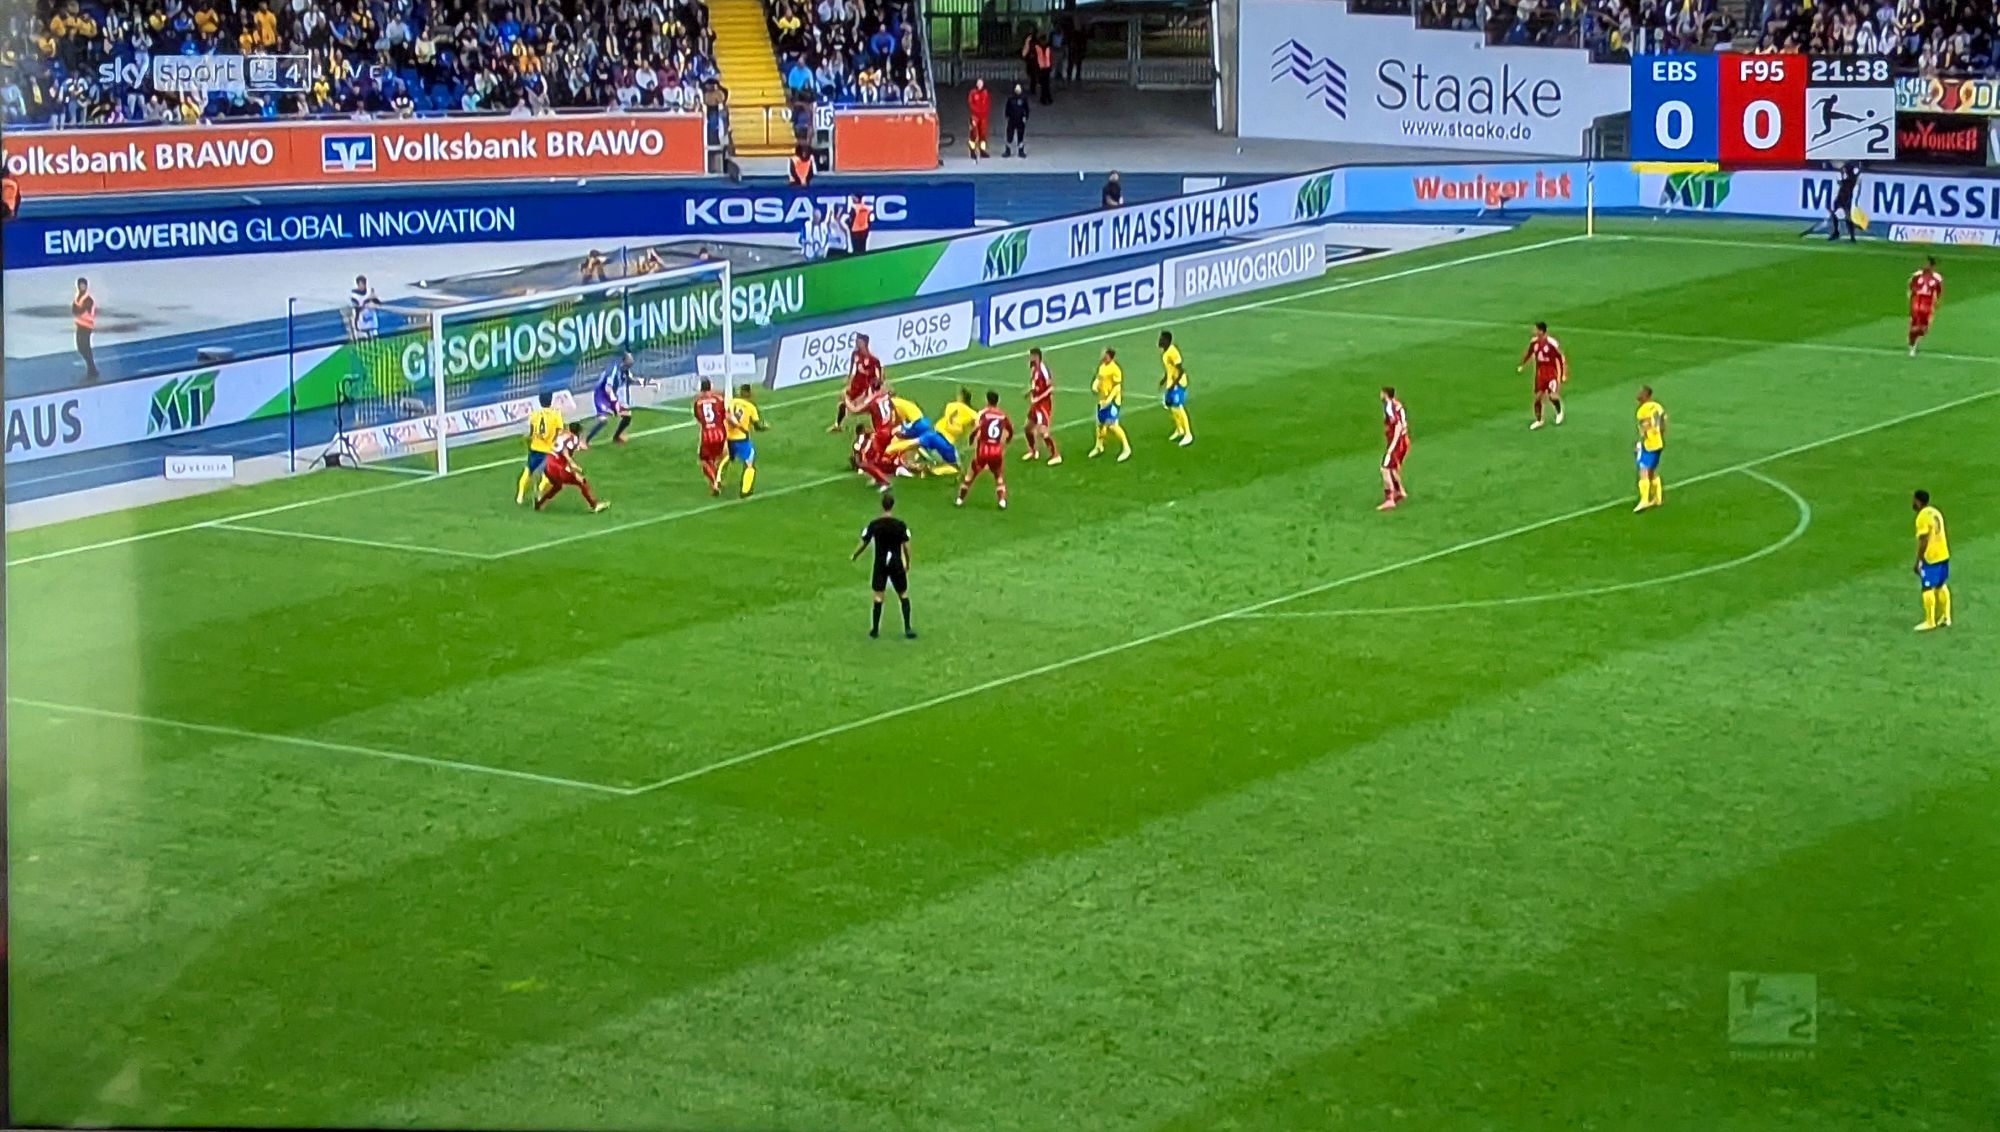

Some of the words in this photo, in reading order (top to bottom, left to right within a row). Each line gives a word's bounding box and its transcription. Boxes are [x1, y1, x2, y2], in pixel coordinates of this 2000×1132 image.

[99, 56, 149, 88] sky
[159, 64, 236, 86] sport
[1376, 59, 1562, 118] Staake
[1652, 61, 1697, 82] EBS
[1740, 61, 1785, 82] F95
[1811, 60, 1889, 82] 21:38
[1655, 100, 1693, 150] 0
[1743, 100, 1781, 150] 0
[156, 138, 274, 171] BRAWO
[383, 130, 537, 162] Volksbank
[547, 128, 664, 158] BRAWO
[1413, 174, 1529, 207] Weniger
[1535, 171, 1571, 200] ist
[45, 220, 238, 254] EMPOWERING
[246, 213, 352, 241] GLOBAL
[360, 206, 515, 238] INNOVATION
[1070, 218, 1103, 258] MT
[1112, 193, 1259, 249] MASSIVHAUS
[1185, 242, 1316, 298] BRAWOGROUP
[994, 277, 1155, 335] KOSATEC
[987, 417, 1001, 440] 6
